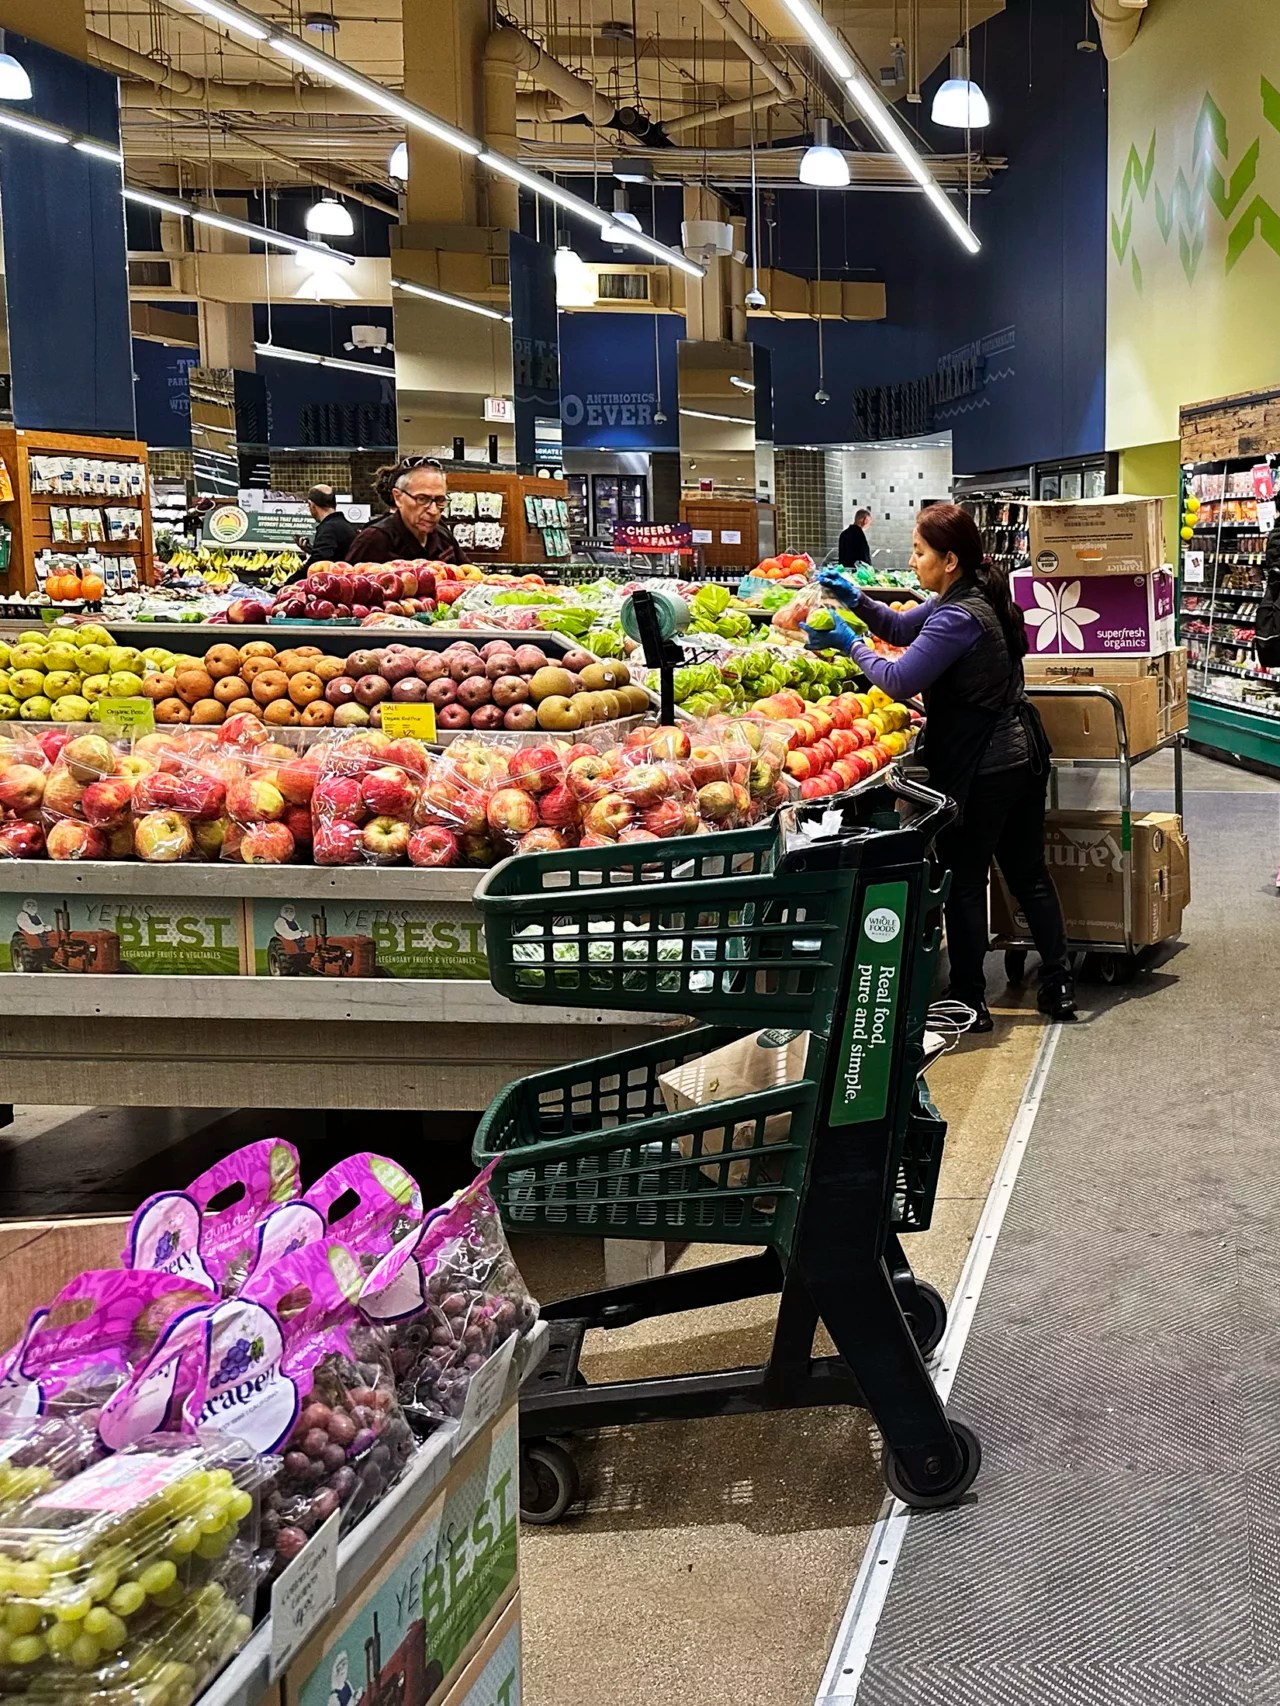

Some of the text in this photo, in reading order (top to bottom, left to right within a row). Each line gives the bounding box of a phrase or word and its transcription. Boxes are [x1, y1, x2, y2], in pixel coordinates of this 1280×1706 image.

[626, 525, 671, 536] CHEERS
[651, 536, 680, 546] FALL
[1106, 559, 1144, 573] Rainier
[1096, 627, 1145, 640] superfresh
[1104, 637, 1146, 650] organics
[86, 904, 153, 923] YETI'S
[343, 909, 411, 928] YETI'S
[869, 916, 896, 926] WHOLE
[115, 916, 231, 948] BEST
[869, 925, 896, 933] FOODS
[371, 922, 483, 953] BEST
[122, 950, 221, 960] LEGENDARY FRUITS & VEGETABLES
[378, 956, 411, 964] LEGENDARY
[441, 957, 477, 965] VEGETABLES
[868, 965, 895, 1049] Real food,
[844, 964, 872, 1104] pure and simple.
[204, 1222, 232, 1245] gum
[422, 1468, 512, 1625] BEST
[396, 1522, 455, 1627] YETI'S
